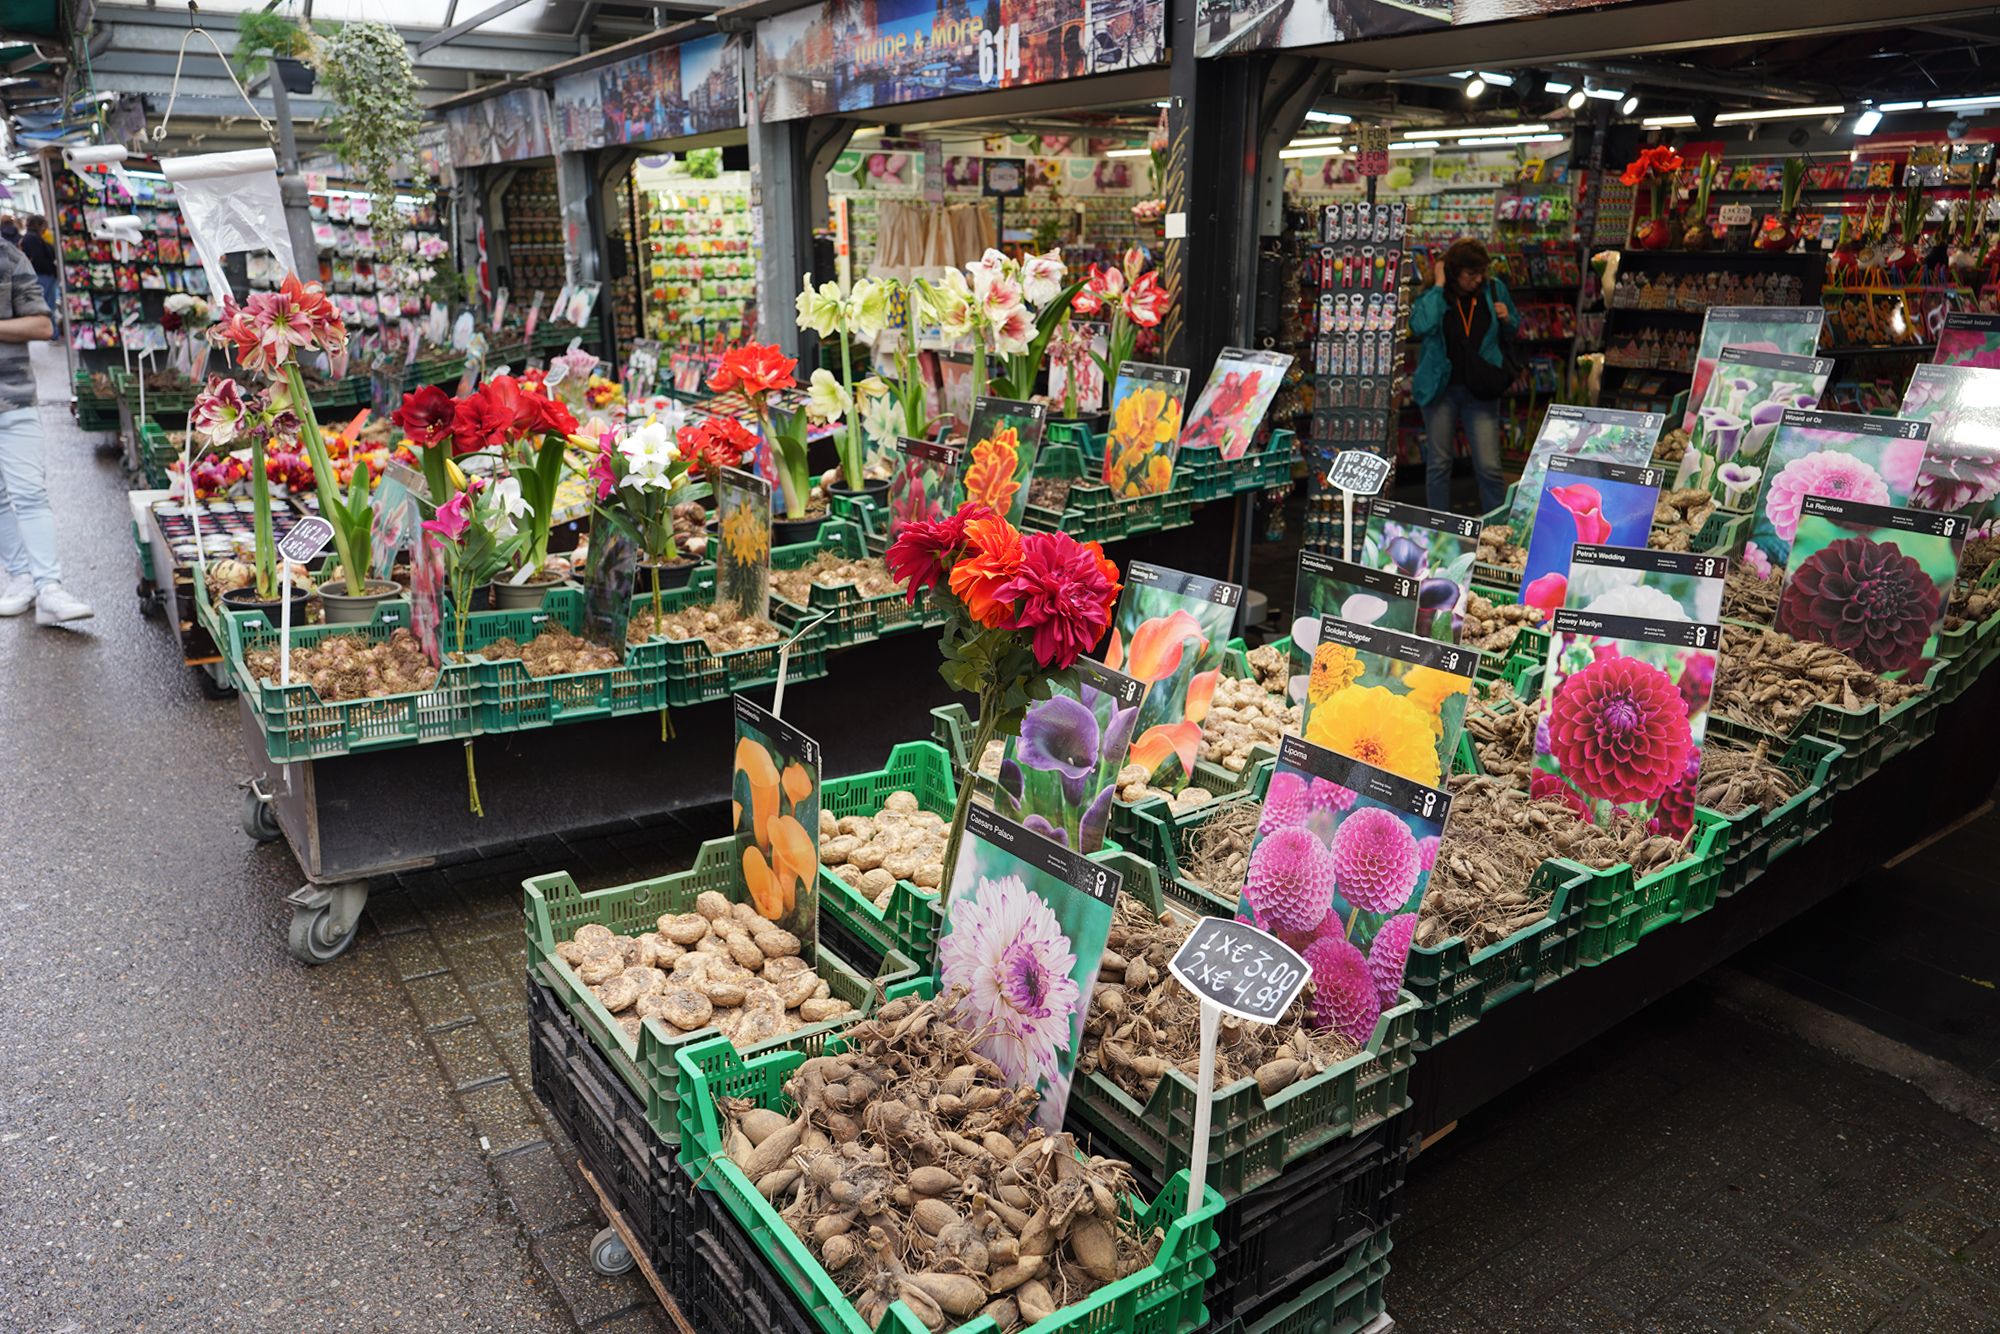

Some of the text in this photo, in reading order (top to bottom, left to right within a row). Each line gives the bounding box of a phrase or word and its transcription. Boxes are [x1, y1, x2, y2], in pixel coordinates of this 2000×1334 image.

[914, 28, 924, 54] &
[931, 15, 984, 49] More
[979, 23, 1020, 84] 614
[1367, 129, 1387, 140] FOR
[1366, 151, 1387, 161] FOR
[1785, 413, 1805, 422] Wizard
[1344, 452, 1382, 471] BIG SIZE
[1805, 501, 1815, 510] La
[1815, 503, 1844, 514] Recoleta
[1575, 549, 1598, 560] Petra's
[1598, 552, 1626, 563] Wedding
[1148, 571, 1159, 580] Sun
[1557, 616, 1603, 629] Jowey Marilyn
[1324, 625, 1347, 639] Golden
[1347, 629, 1371, 645] Scepter
[1283, 744, 1308, 761] Lipoma
[970, 812, 993, 832] Caesars
[993, 825, 1014, 842] Palace
